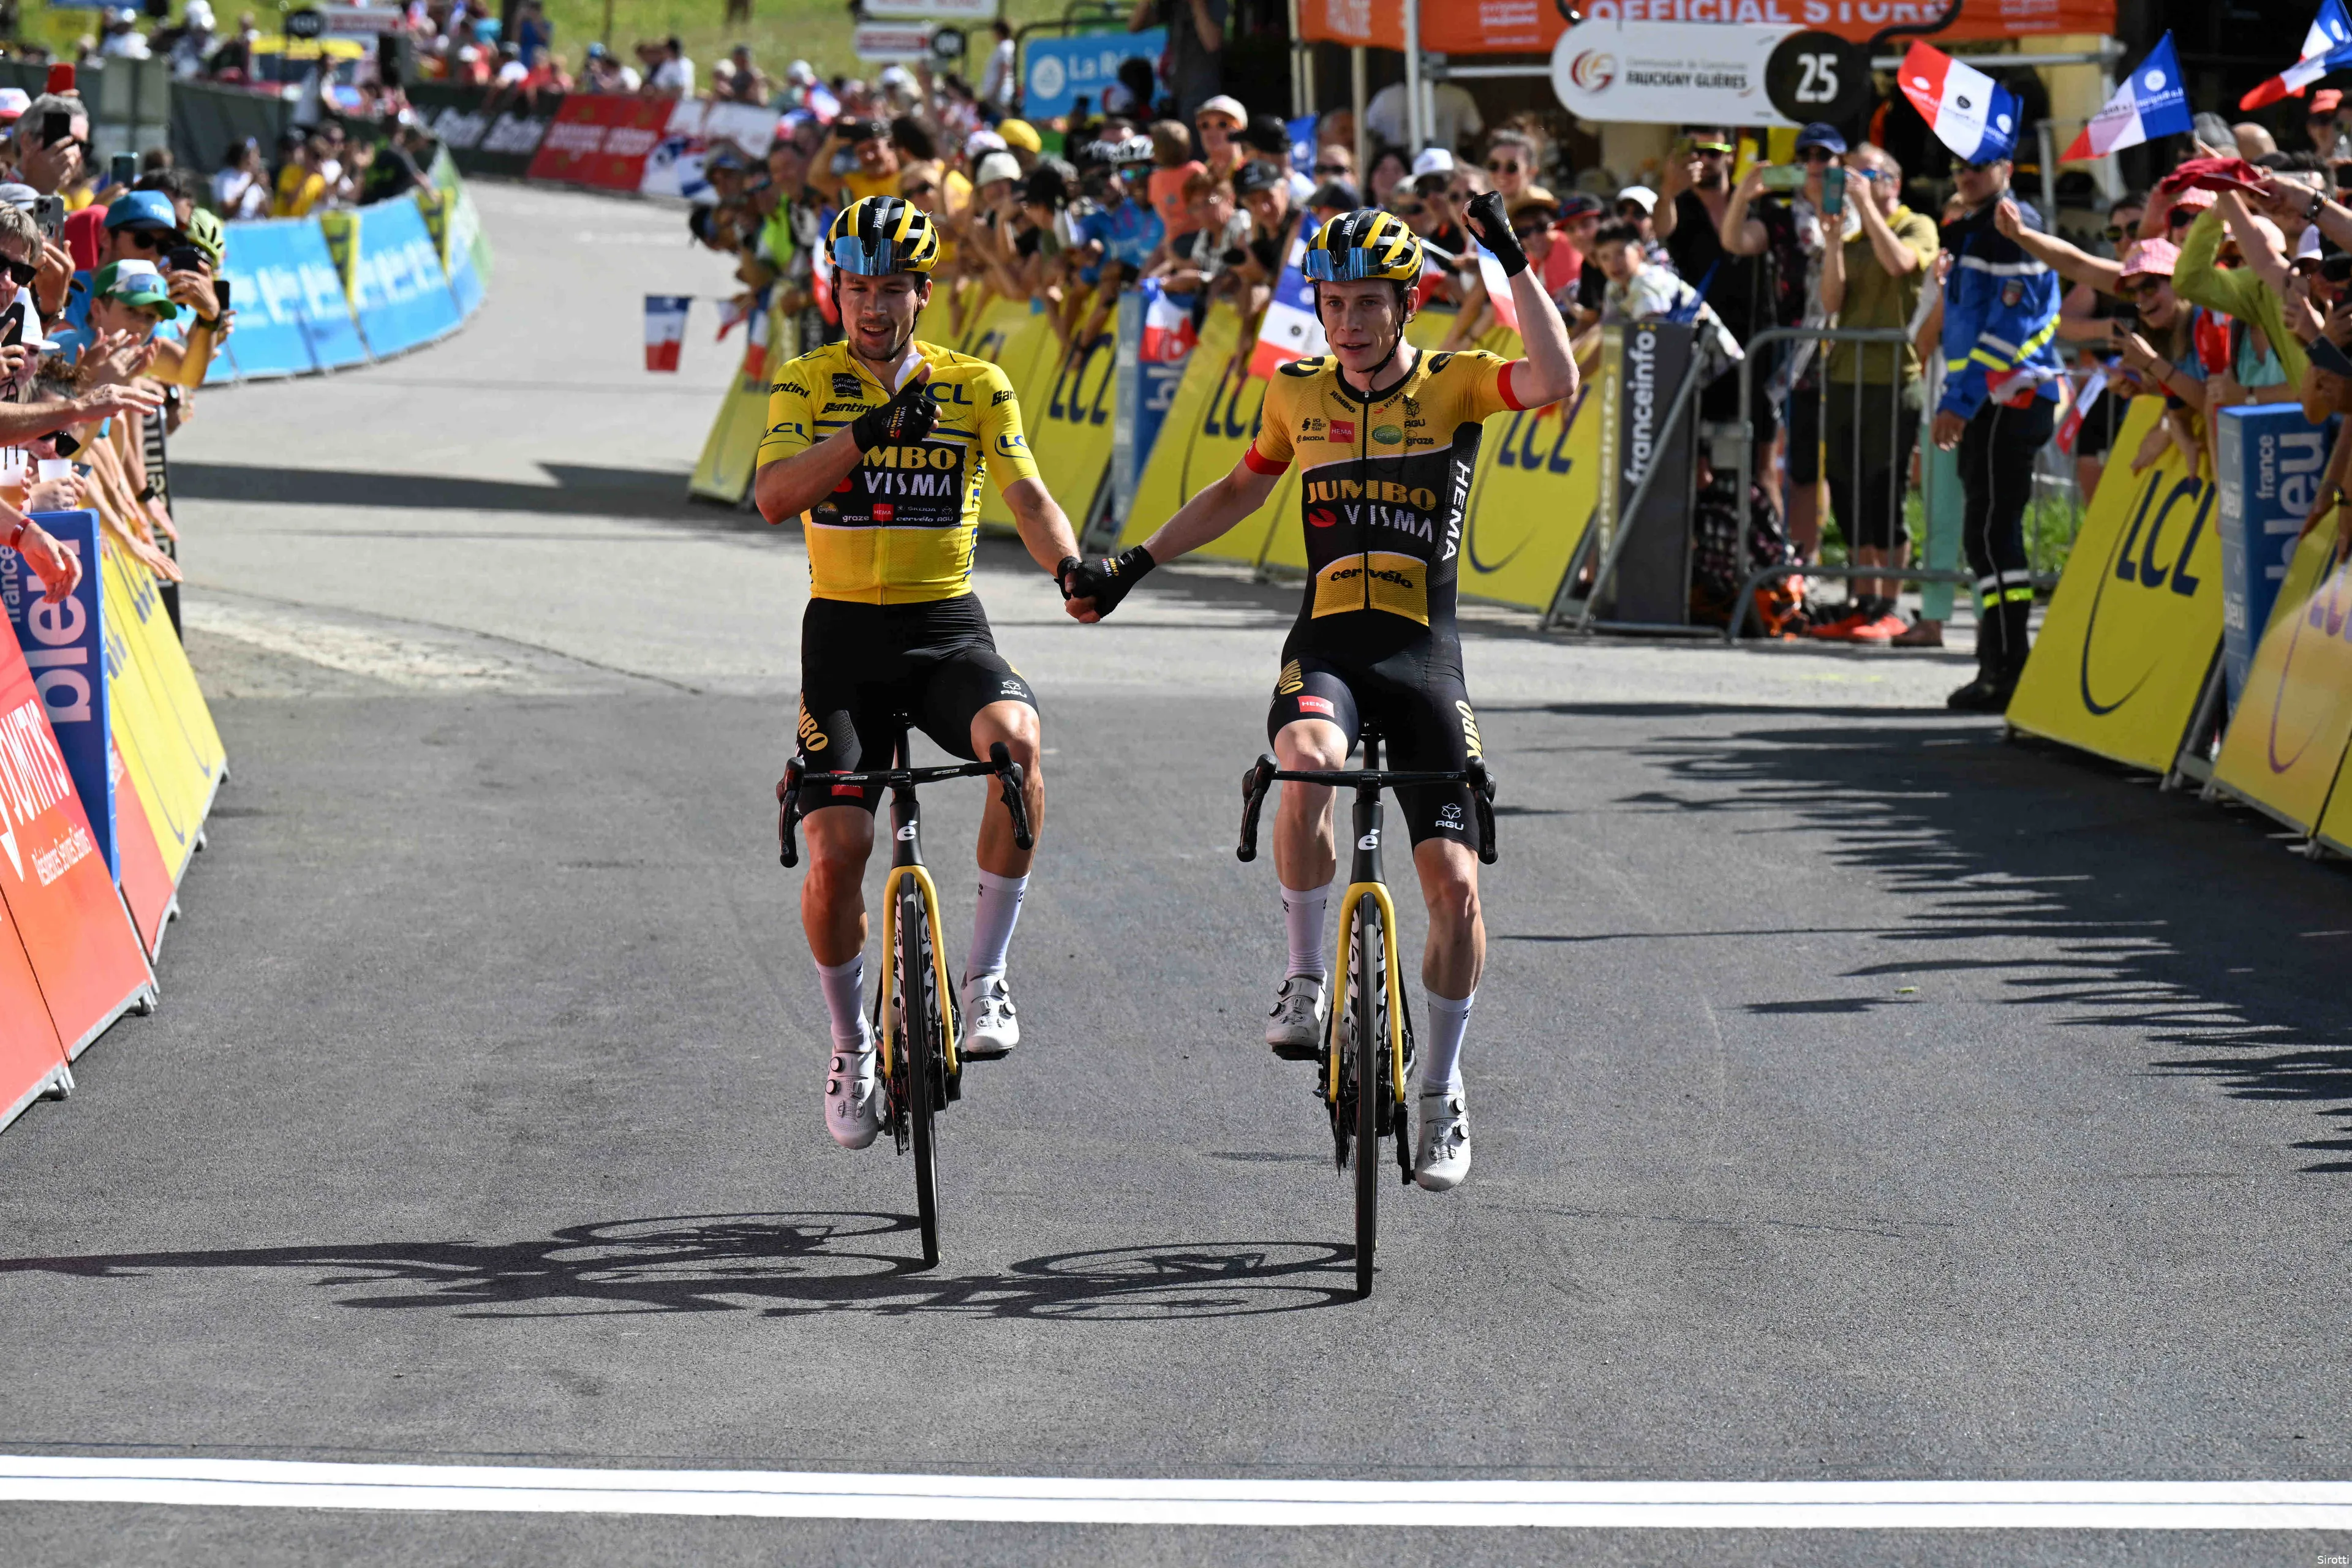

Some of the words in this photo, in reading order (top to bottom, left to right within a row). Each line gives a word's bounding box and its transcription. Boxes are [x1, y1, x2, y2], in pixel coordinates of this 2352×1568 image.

[1626, 71, 1690, 87] FAUCIGNY
[1794, 54, 1838, 102] 25
[873, 208, 886, 229] PRIMOŽ
[1342, 220, 1355, 236] JONAS
[925, 382, 973, 405] CL
[1329, 390, 1356, 413] JUMBO
[1384, 391, 1404, 409] VISMA
[821, 402, 877, 414] Santini
[889, 406, 901, 438] JUMBO
[1404, 418, 1426, 428] AGU
[1000, 435, 1029, 448] LC
[1405, 437, 1434, 447] graze
[863, 445, 957, 470] MBO
[2256, 434, 2275, 500] france
[864, 471, 952, 497] VISMA
[1308, 480, 1436, 511] JUMBO
[842, 514, 870, 523] graze
[1442, 459, 1471, 562] HEMA
[1344, 504, 1433, 543] VISMA
[2116, 469, 2218, 597] LCL
[1330, 567, 1414, 589] cervélo
[1000, 690, 1027, 698] AGU
[1455, 699, 1483, 759] MBO
[1435, 820, 1464, 831] AGU
